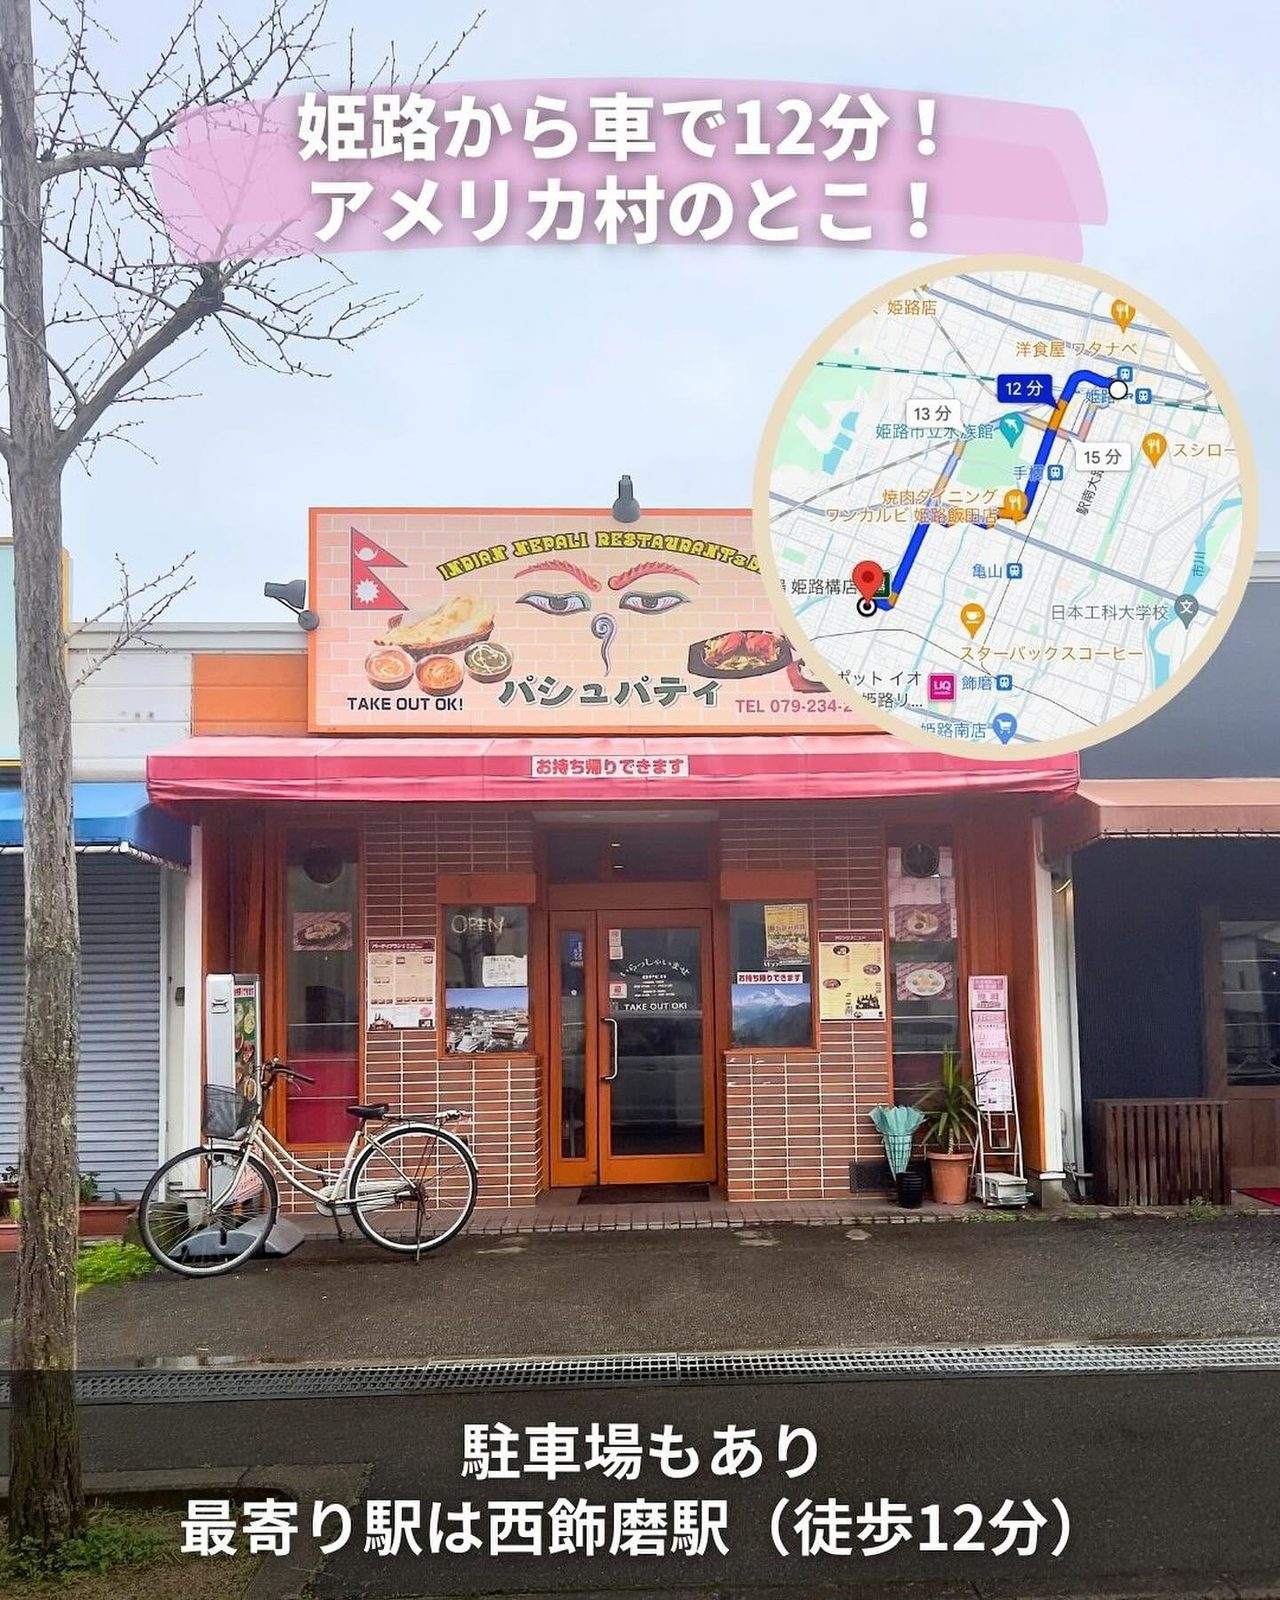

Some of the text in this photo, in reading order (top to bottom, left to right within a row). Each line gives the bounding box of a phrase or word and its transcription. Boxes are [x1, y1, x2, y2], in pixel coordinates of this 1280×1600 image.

[437, 545, 507, 581] INDIAN
[513, 532, 589, 557] NEPALI
[498, 676, 721, 708] パシュパティ
[347, 697, 464, 711] TAKE OUT OK!
[735, 700, 765, 713] TEL
[535, 758, 685, 776] お持ち帰りできます
[451, 914, 504, 934] OPEN
[619, 958, 690, 977] いらっしゃいませ
[624, 1003, 648, 1011] TAKE
[649, 1002, 670, 1011] OUT
